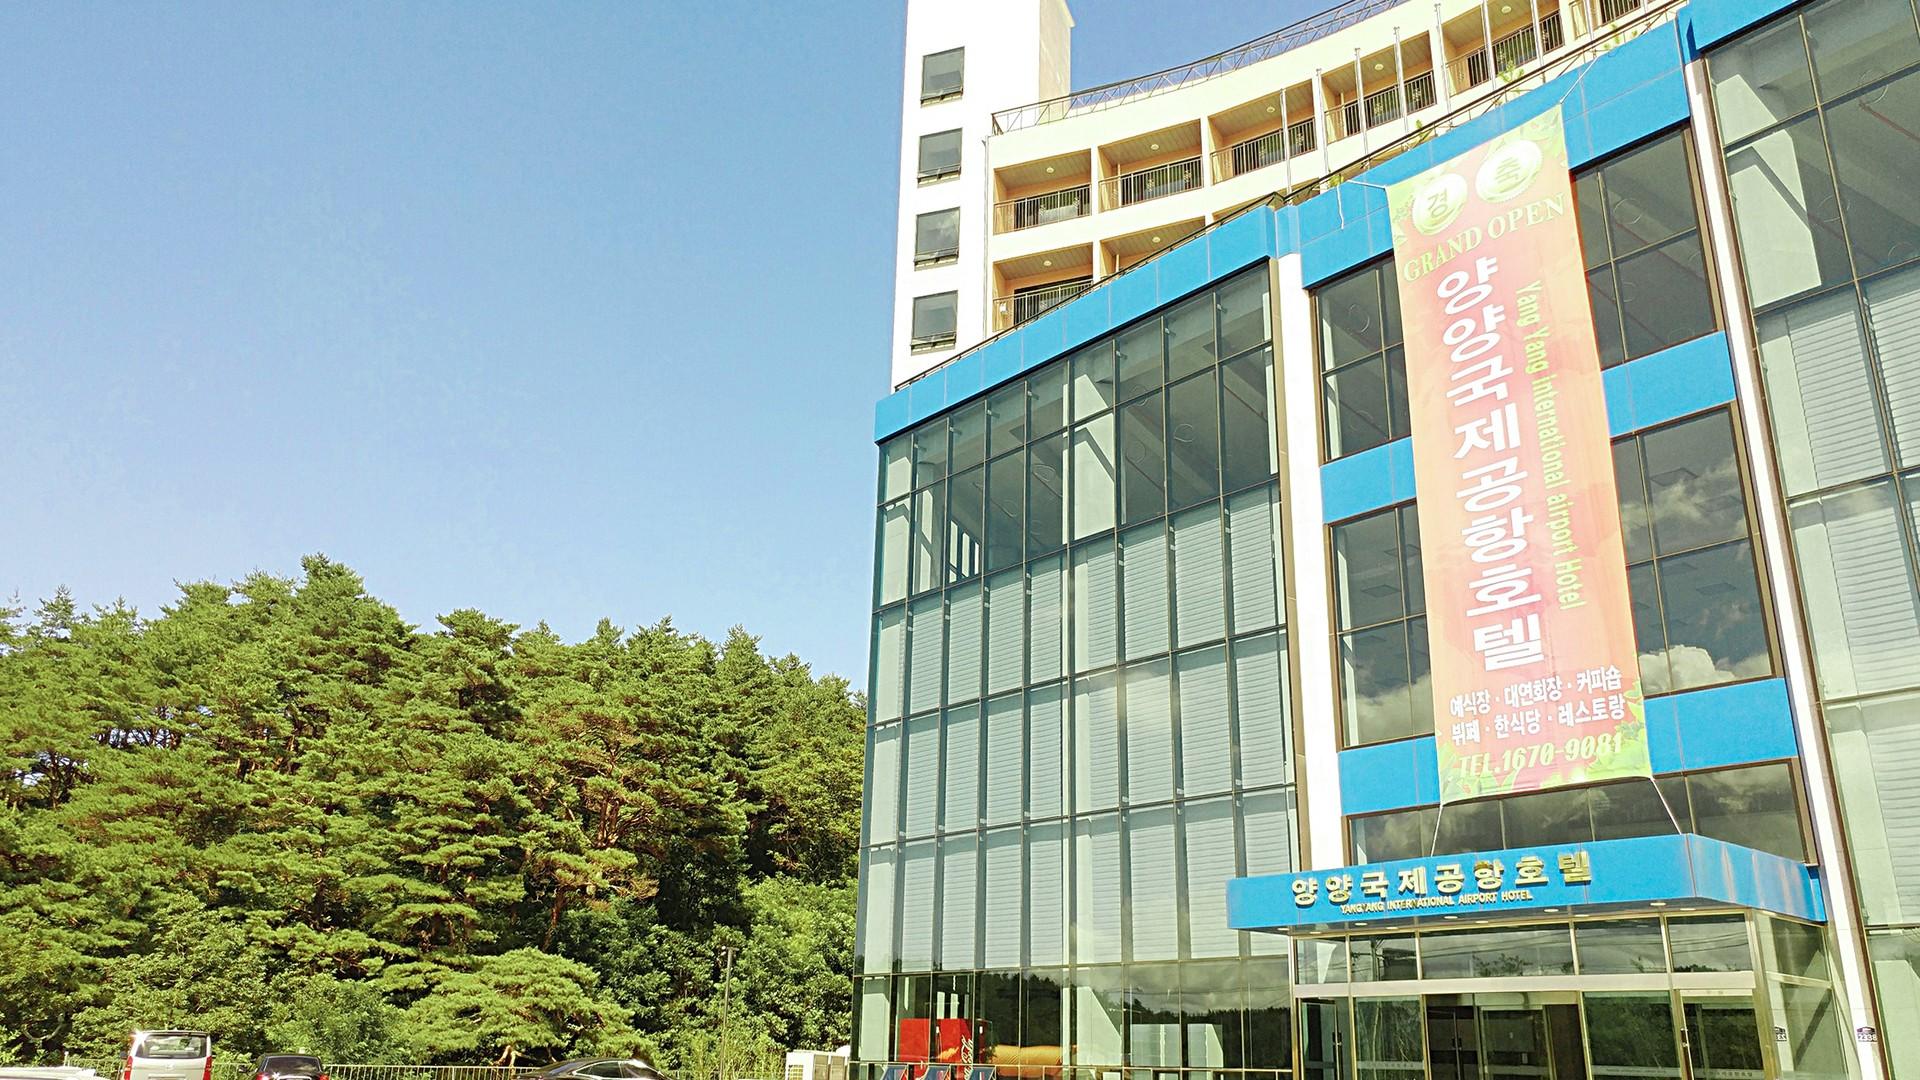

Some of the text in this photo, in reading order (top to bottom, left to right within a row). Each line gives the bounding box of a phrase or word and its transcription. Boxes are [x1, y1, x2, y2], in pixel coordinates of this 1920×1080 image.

[1404, 193, 1565, 282] GRAND OPEN
[1437, 256, 1545, 672] 양양국제공항호텔
[1516, 280, 1587, 610] Yang Yang international airport Hotel
[1450, 665, 1622, 718] 예식장 대연회장 커피숍
[1494, 709, 1541, 739] 한식당
[1558, 694, 1626, 728] 레스토랑
[1291, 850, 1593, 906] 양양국제공항호텔
[1387, 895, 1454, 912] INTERNATIONAL
[1458, 891, 1498, 905] AIRPORT
[1501, 889, 1534, 902] HOTEL
